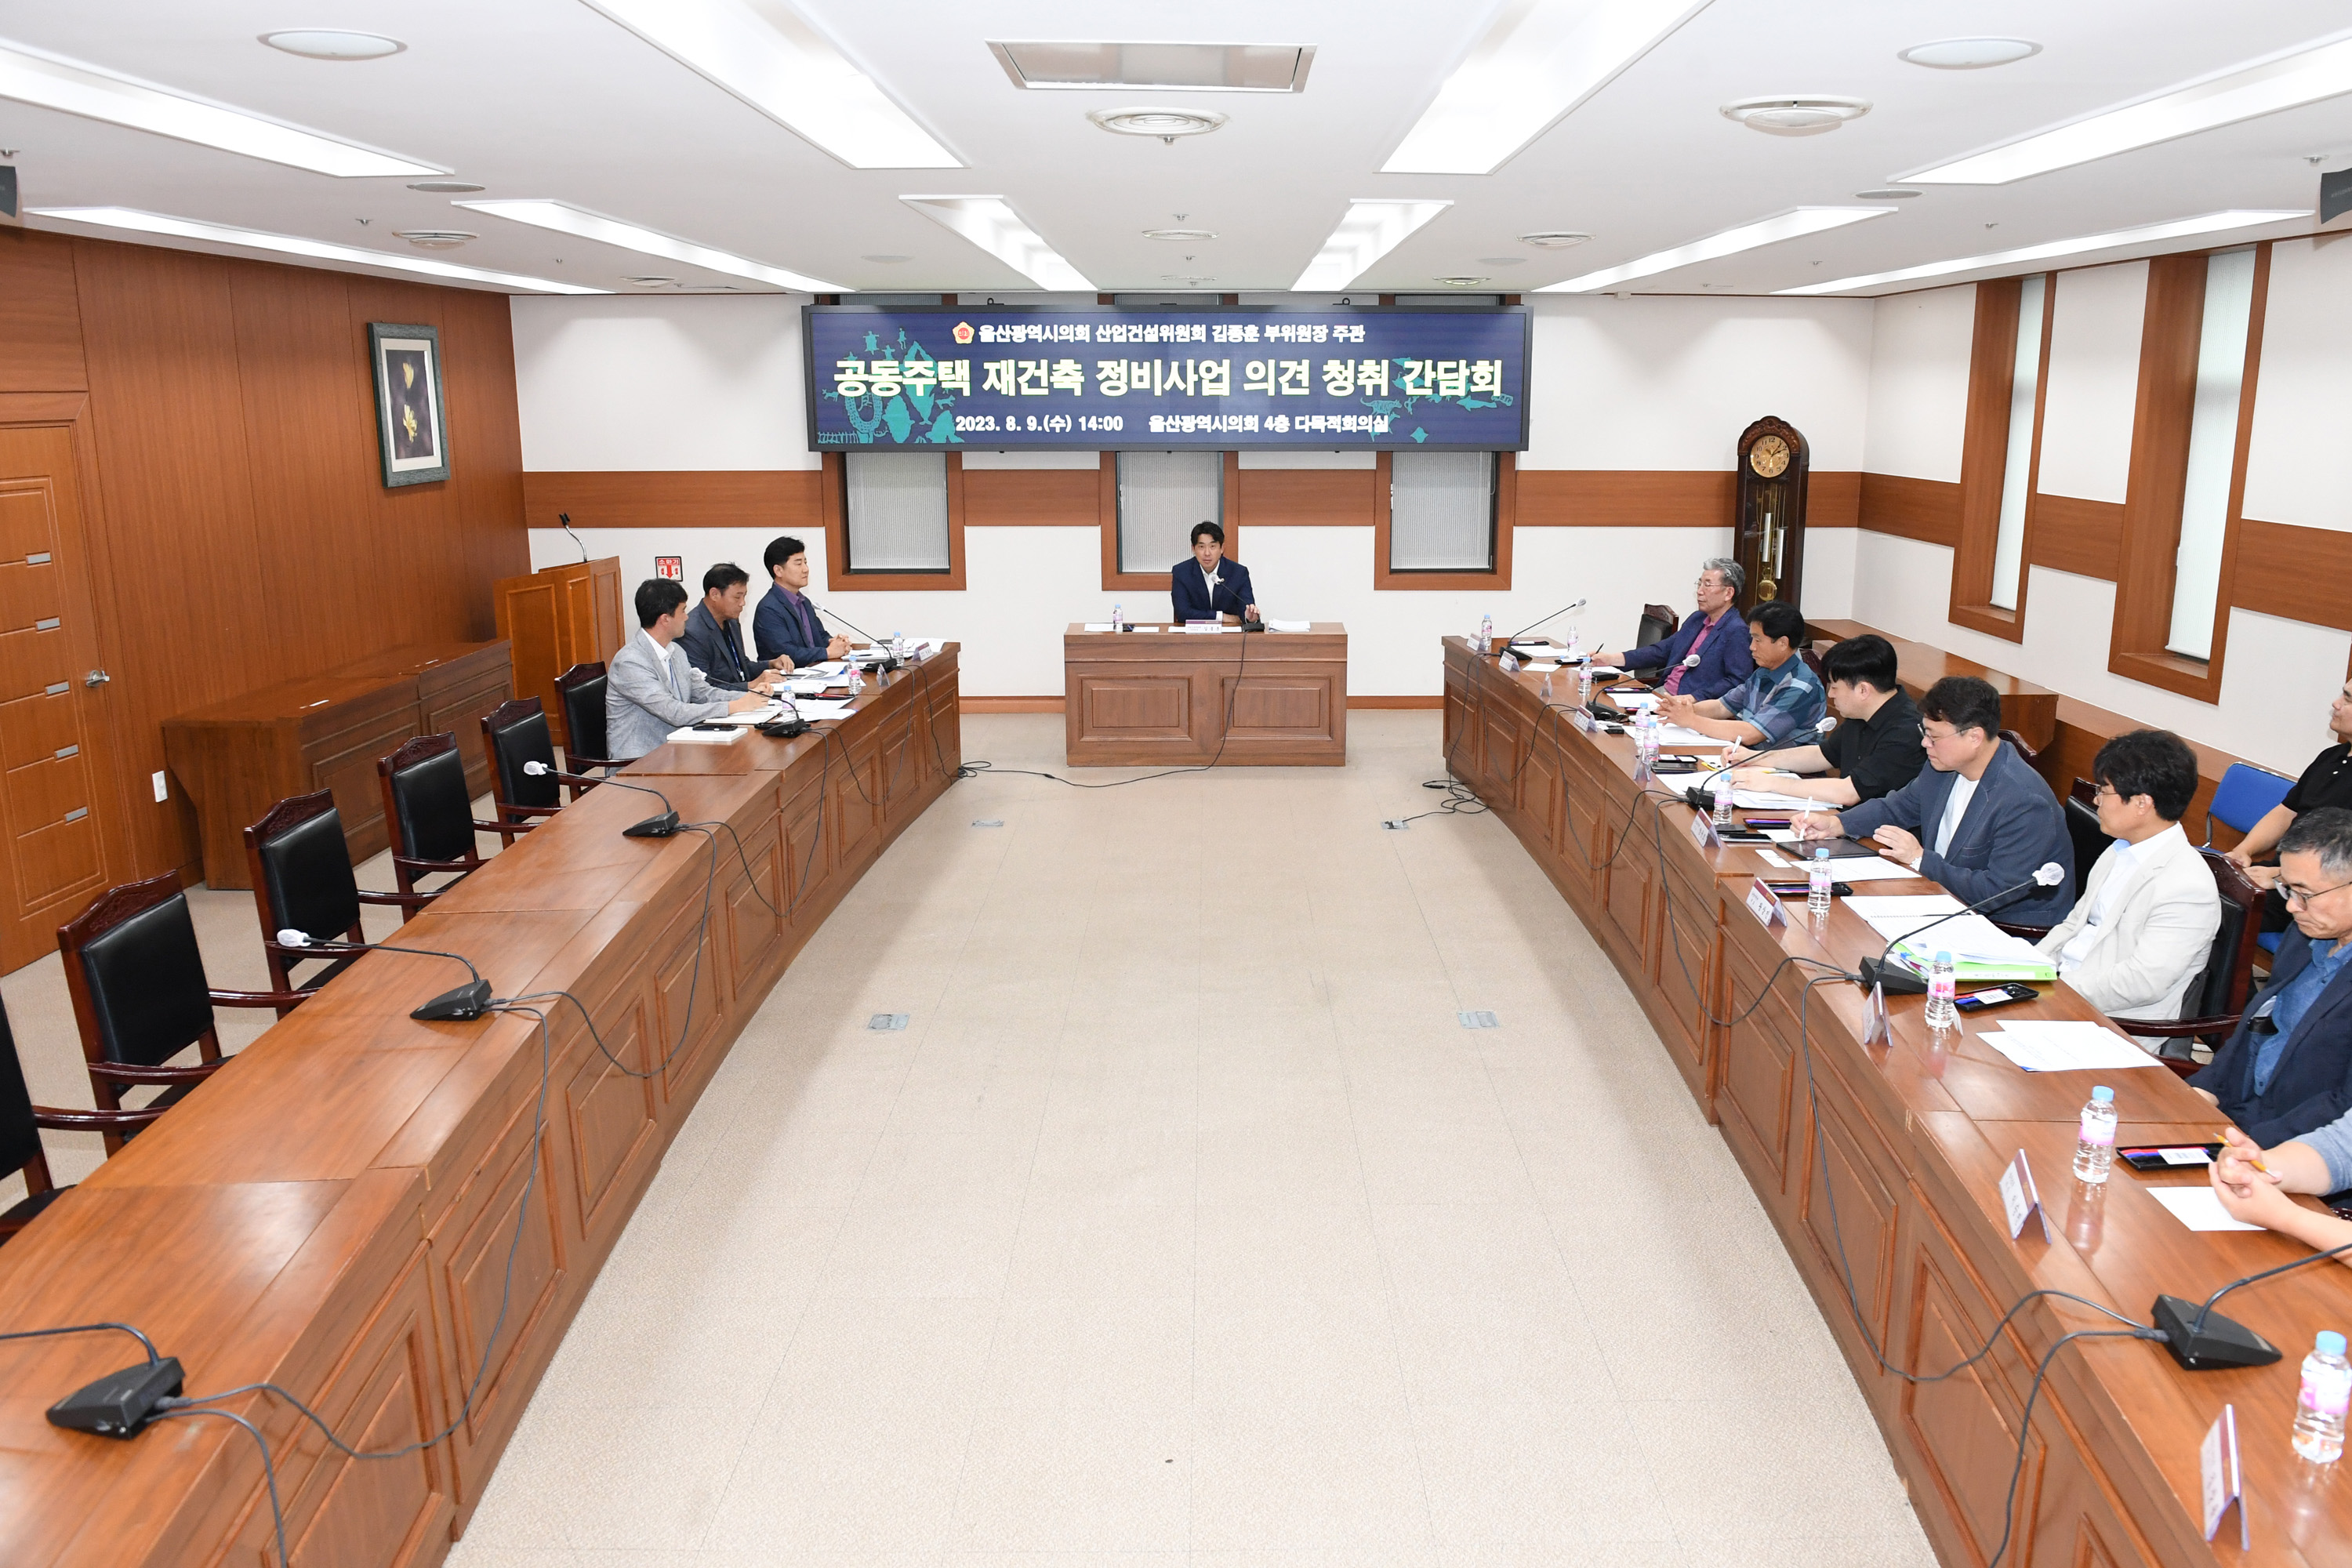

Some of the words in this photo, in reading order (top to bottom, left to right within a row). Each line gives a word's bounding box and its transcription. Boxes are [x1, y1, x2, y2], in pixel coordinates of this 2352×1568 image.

[978, 324, 1091, 343] 울산광역시의회
[1095, 324, 1207, 343] 산업건설위원회
[1211, 324, 1260, 343] 김종훈
[1264, 324, 1329, 343] 부위원장
[1332, 325, 1366, 343] 주관
[833, 359, 971, 397] 공동주택
[982, 359, 1085, 397] 재건축
[1095, 358, 1230, 397] 정비사업
[1243, 359, 1310, 396] 의견
[1321, 359, 1389, 397] 청취
[1403, 359, 1502, 397] 간담회
[955, 416, 1000, 431] 2023.
[1005, 416, 1022, 431] 8.
[1026, 414, 1072, 433] 9.(수)
[1078, 416, 1123, 431] 14:00
[1149, 414, 1259, 433] 울산광역시의회
[1264, 414, 1290, 433] 4층
[1294, 415, 1388, 434] 다목적회의실
